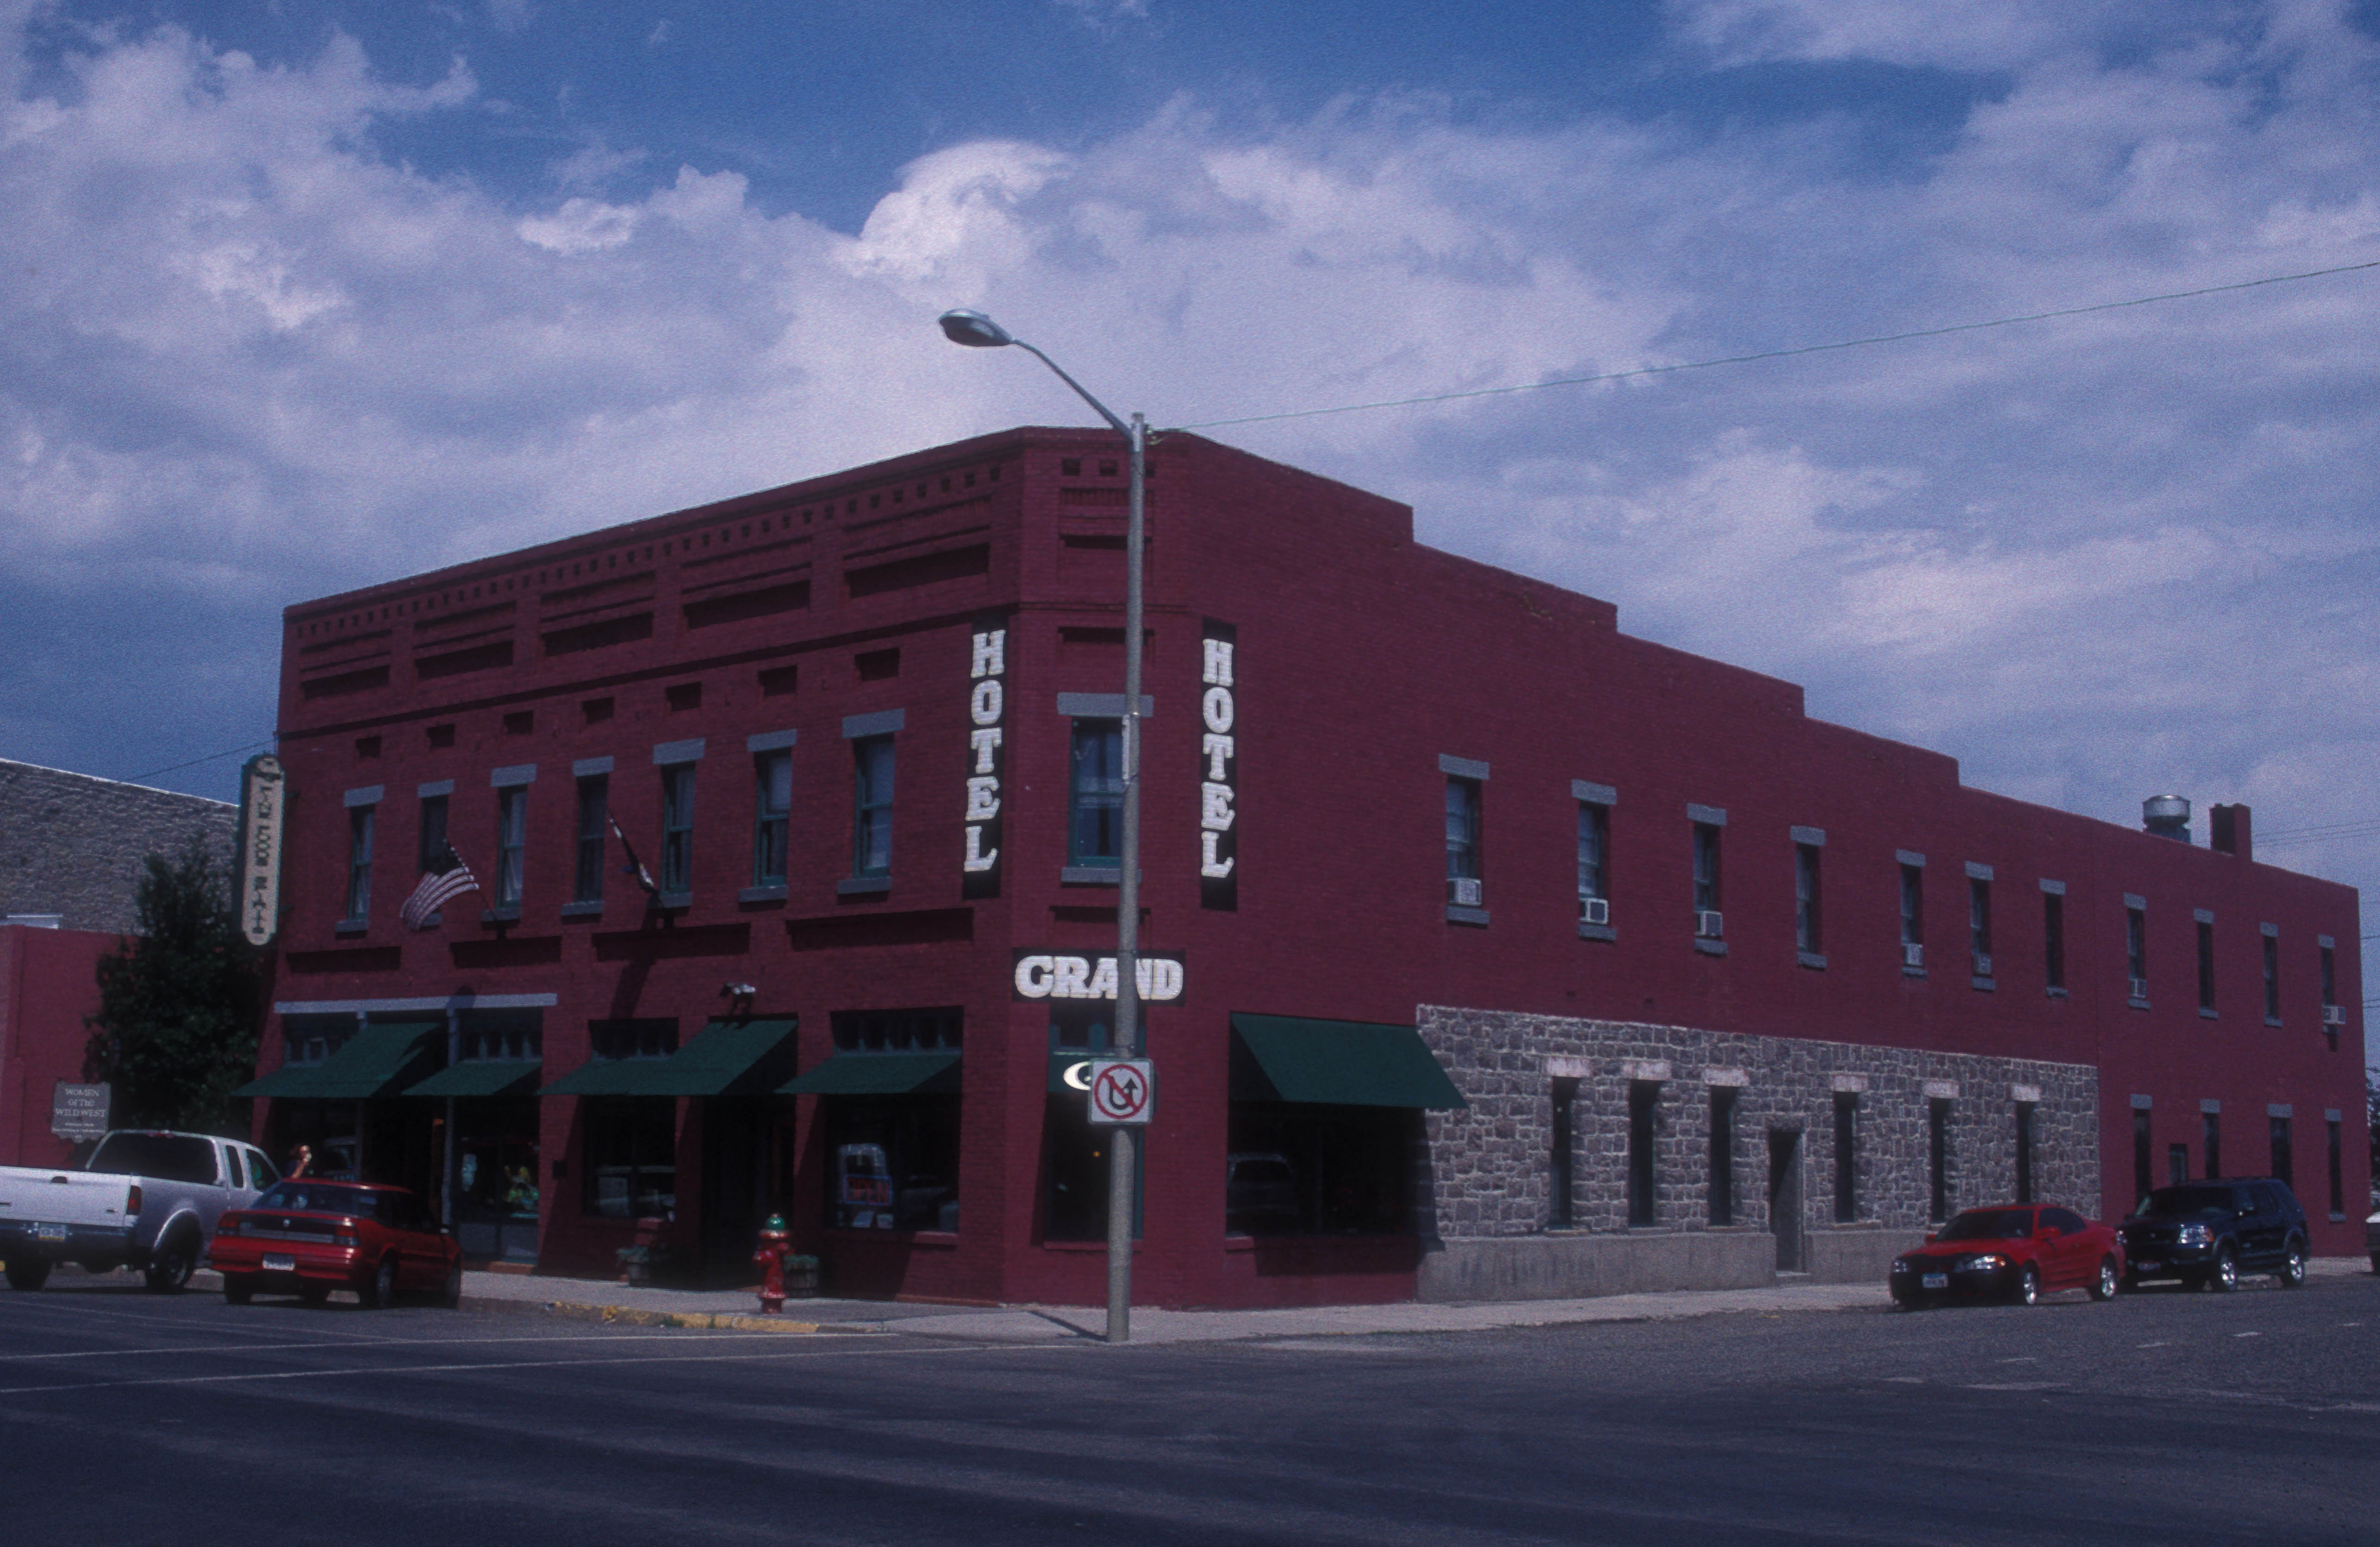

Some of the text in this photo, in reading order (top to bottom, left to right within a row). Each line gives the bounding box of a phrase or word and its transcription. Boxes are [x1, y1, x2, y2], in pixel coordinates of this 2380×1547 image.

[963, 629, 1006, 872] HOTEL
[1201, 638, 1235, 879] HOTEL
[65, 1088, 100, 1097] WOMEN
[55, 1108, 106, 1118] WILD WEST
[846, 1177, 889, 1206] OPEN
